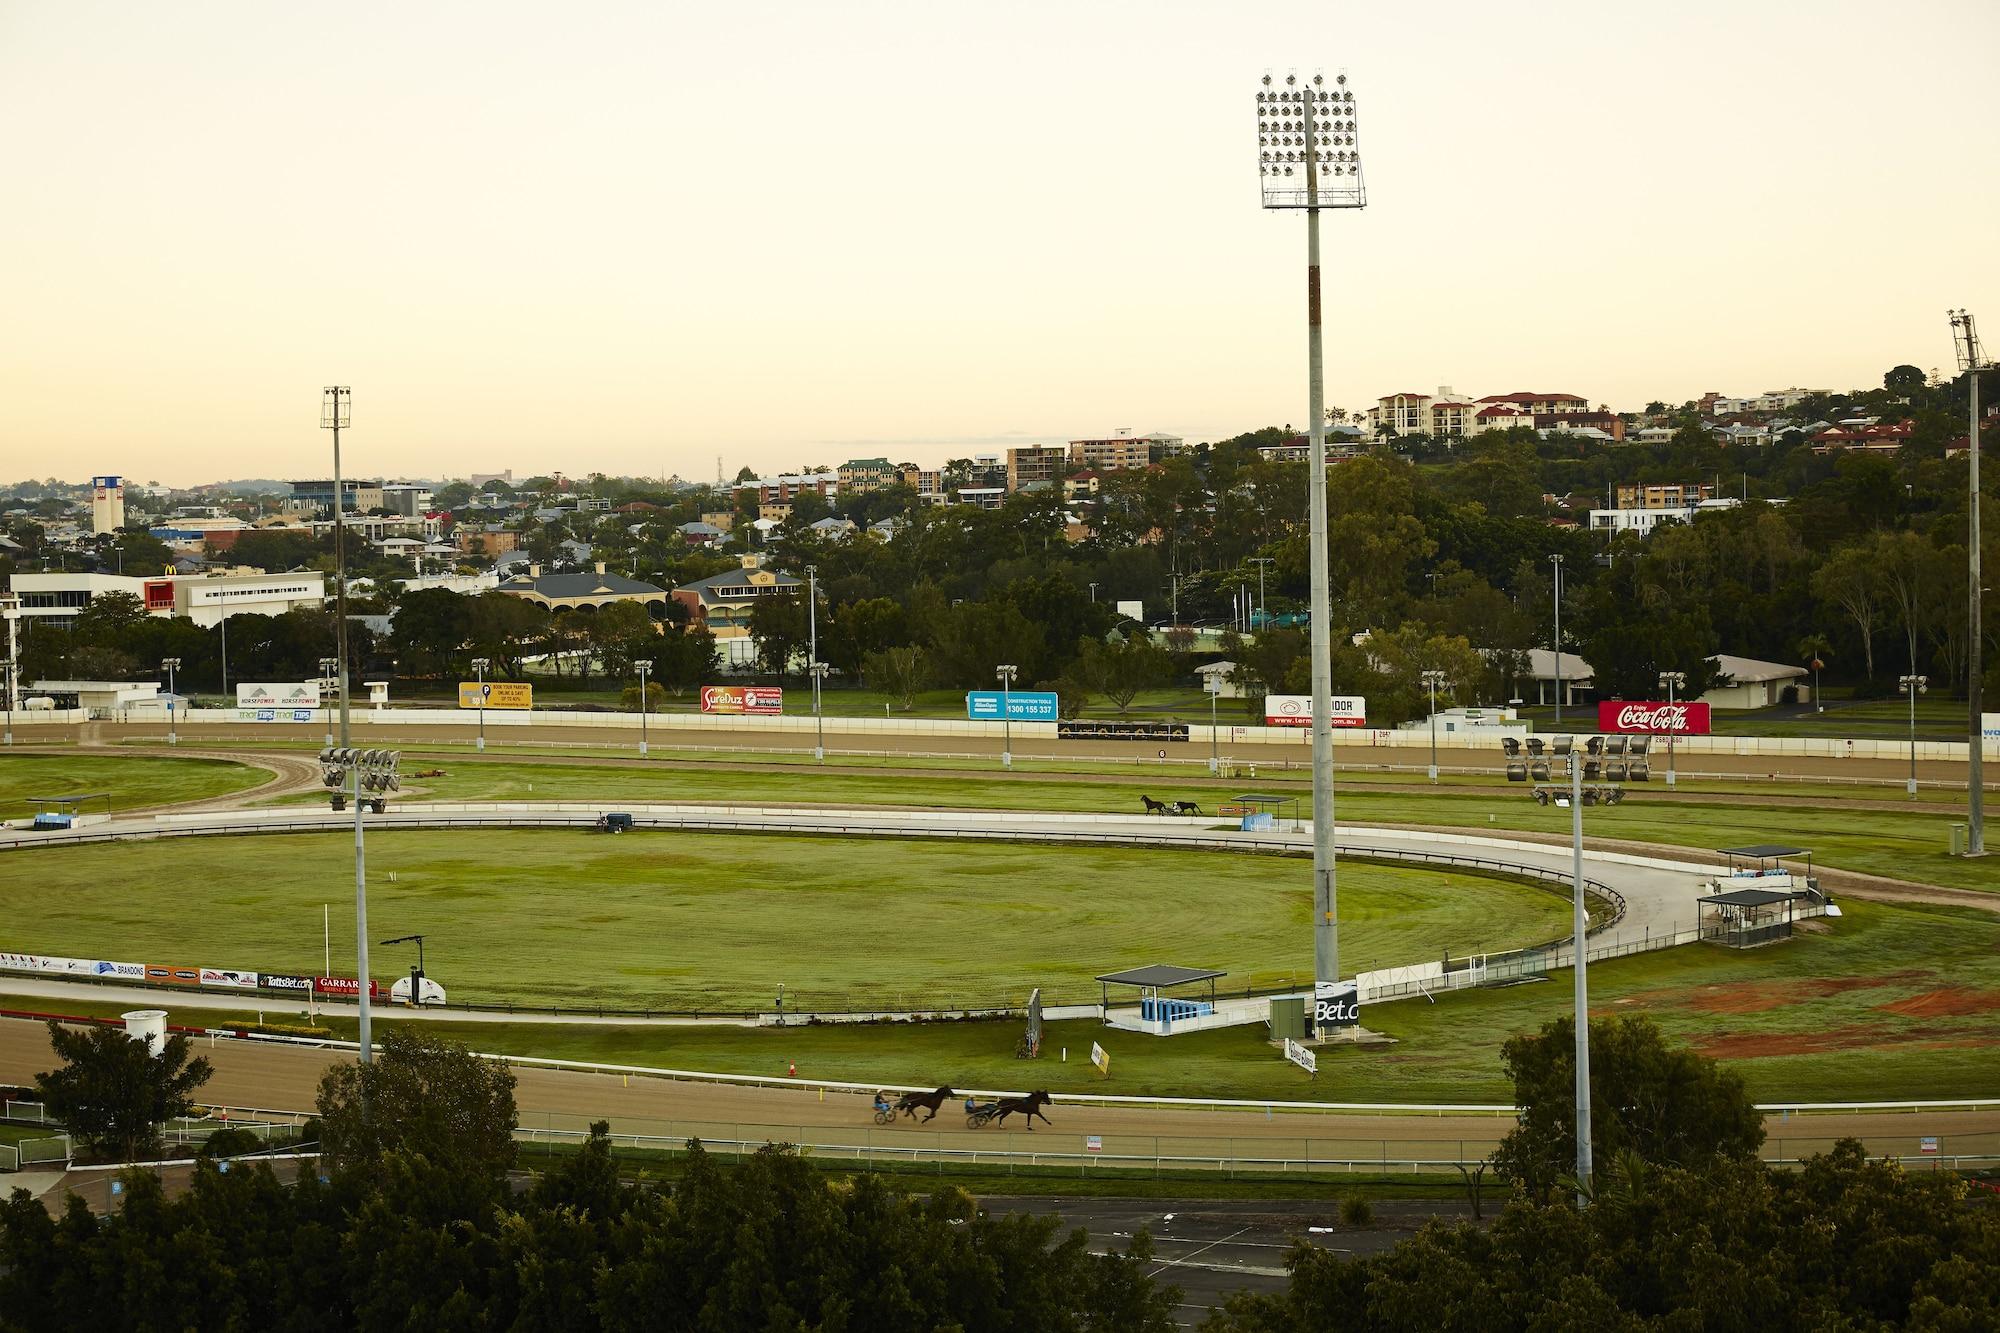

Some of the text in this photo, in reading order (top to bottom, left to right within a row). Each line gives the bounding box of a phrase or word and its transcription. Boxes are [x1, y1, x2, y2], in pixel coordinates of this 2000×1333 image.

[1306, 700, 1352, 710] TIDOR
[118, 966, 143, 975] BRANDONS
[320, 978, 372, 988] GARRARS
